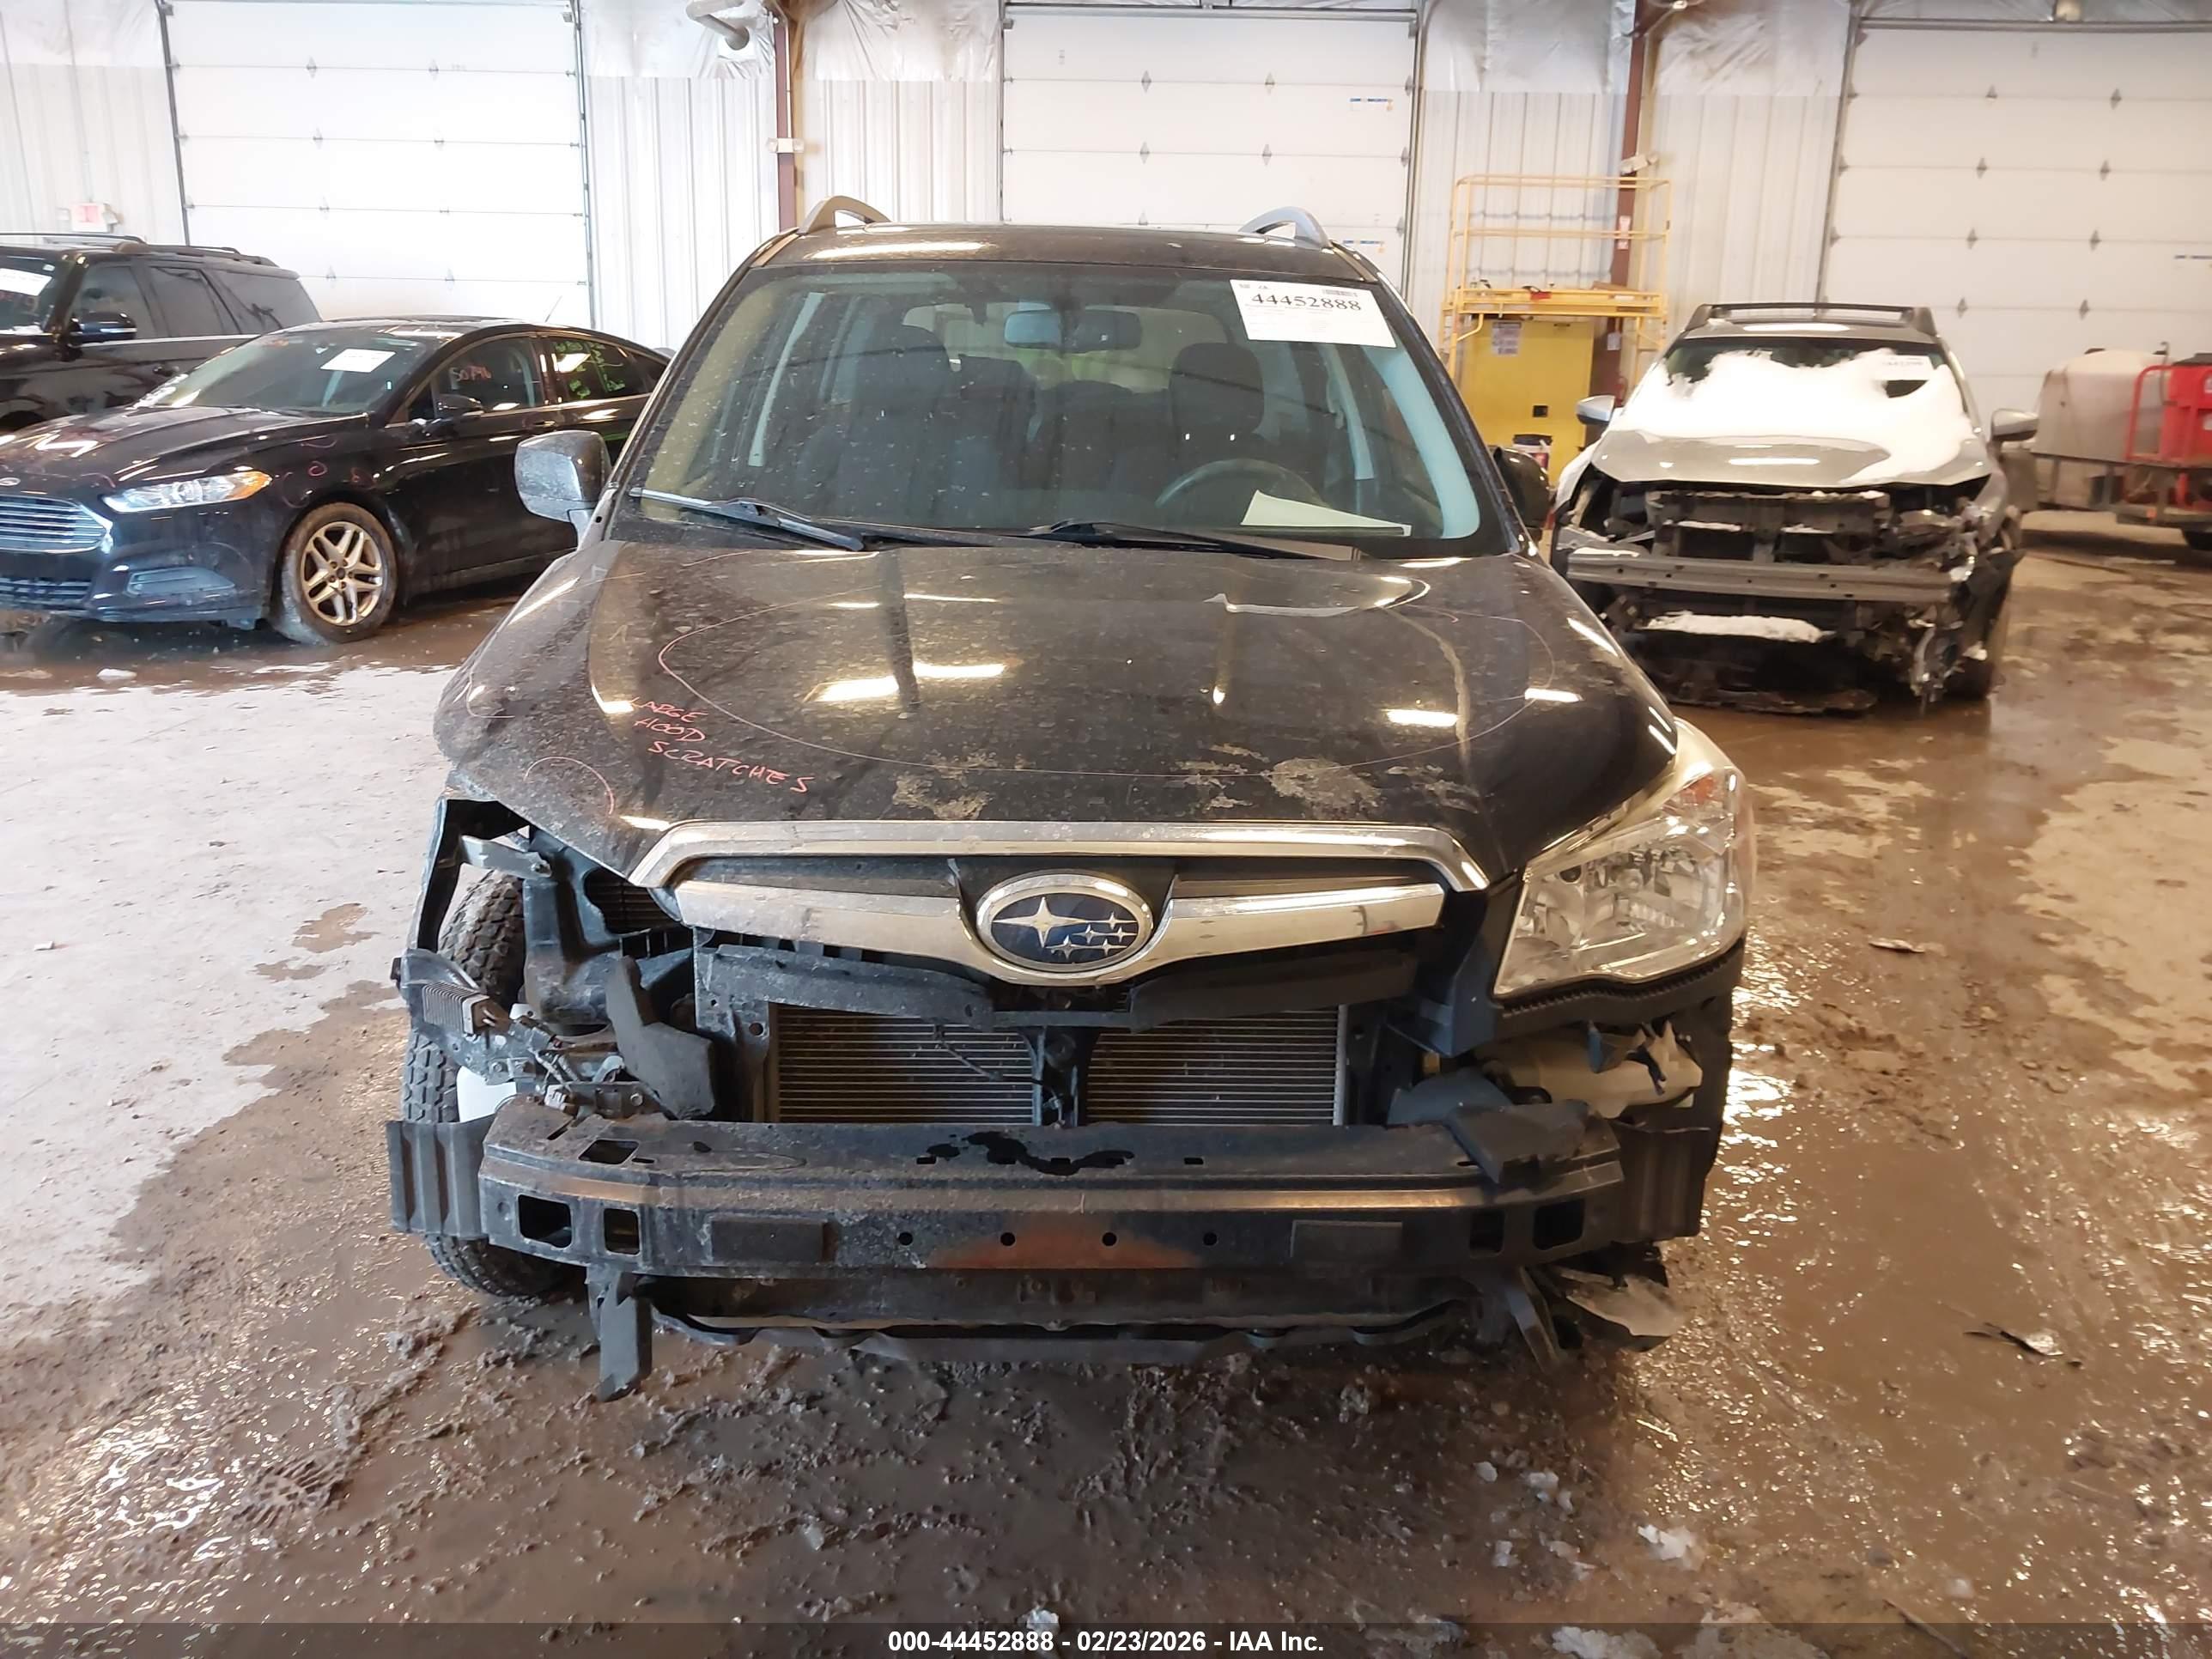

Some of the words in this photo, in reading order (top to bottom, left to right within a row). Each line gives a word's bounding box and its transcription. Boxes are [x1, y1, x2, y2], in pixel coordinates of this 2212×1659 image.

[1251, 293, 1362, 312] 44452888
[630, 696, 709, 723] LARGE
[634, 718, 707, 743] HOOD
[647, 740, 816, 794] SCRATCHES
